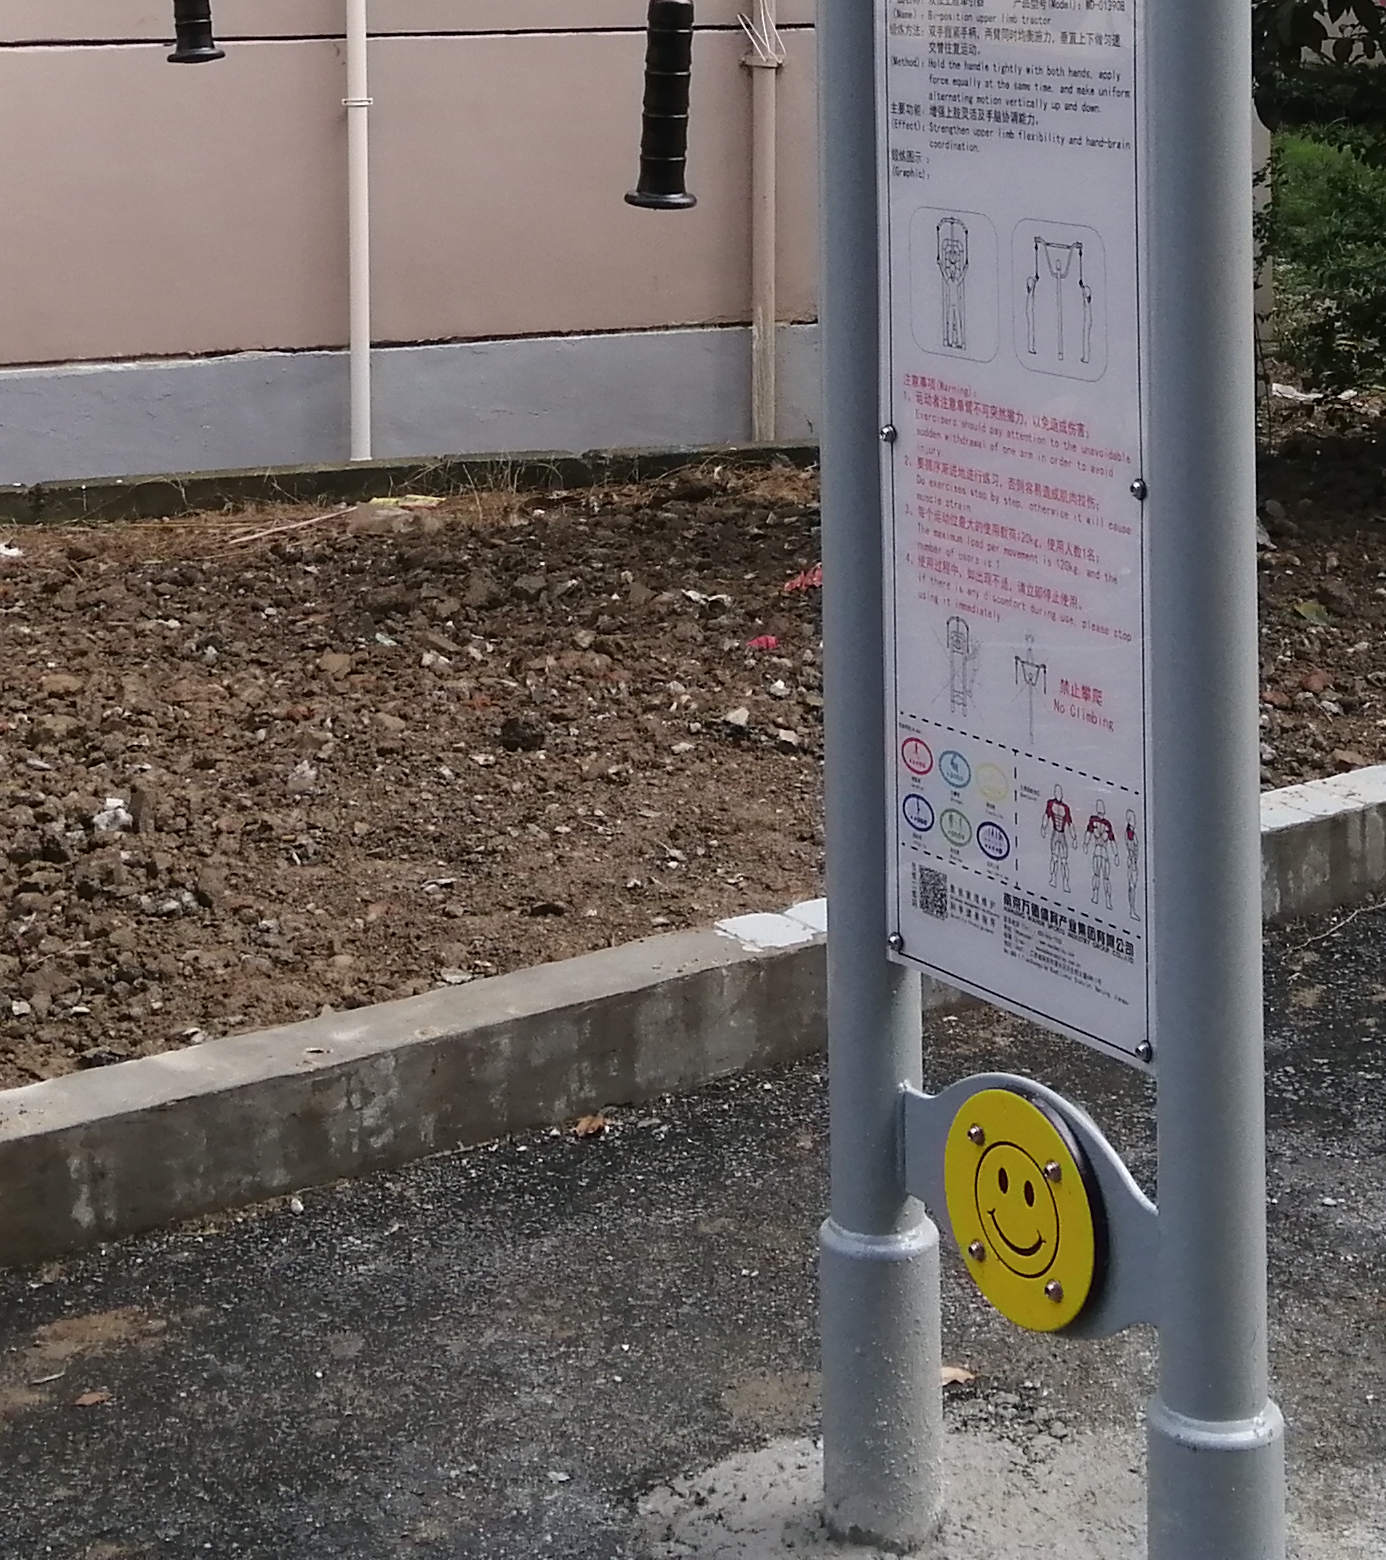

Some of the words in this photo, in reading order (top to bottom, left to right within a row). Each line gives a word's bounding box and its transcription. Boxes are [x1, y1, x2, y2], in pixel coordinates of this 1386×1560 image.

[1059, 678, 1103, 708] 禁止攀爬
[1053, 698, 1066, 714] No
[1070, 703, 1115, 733] Climbing
